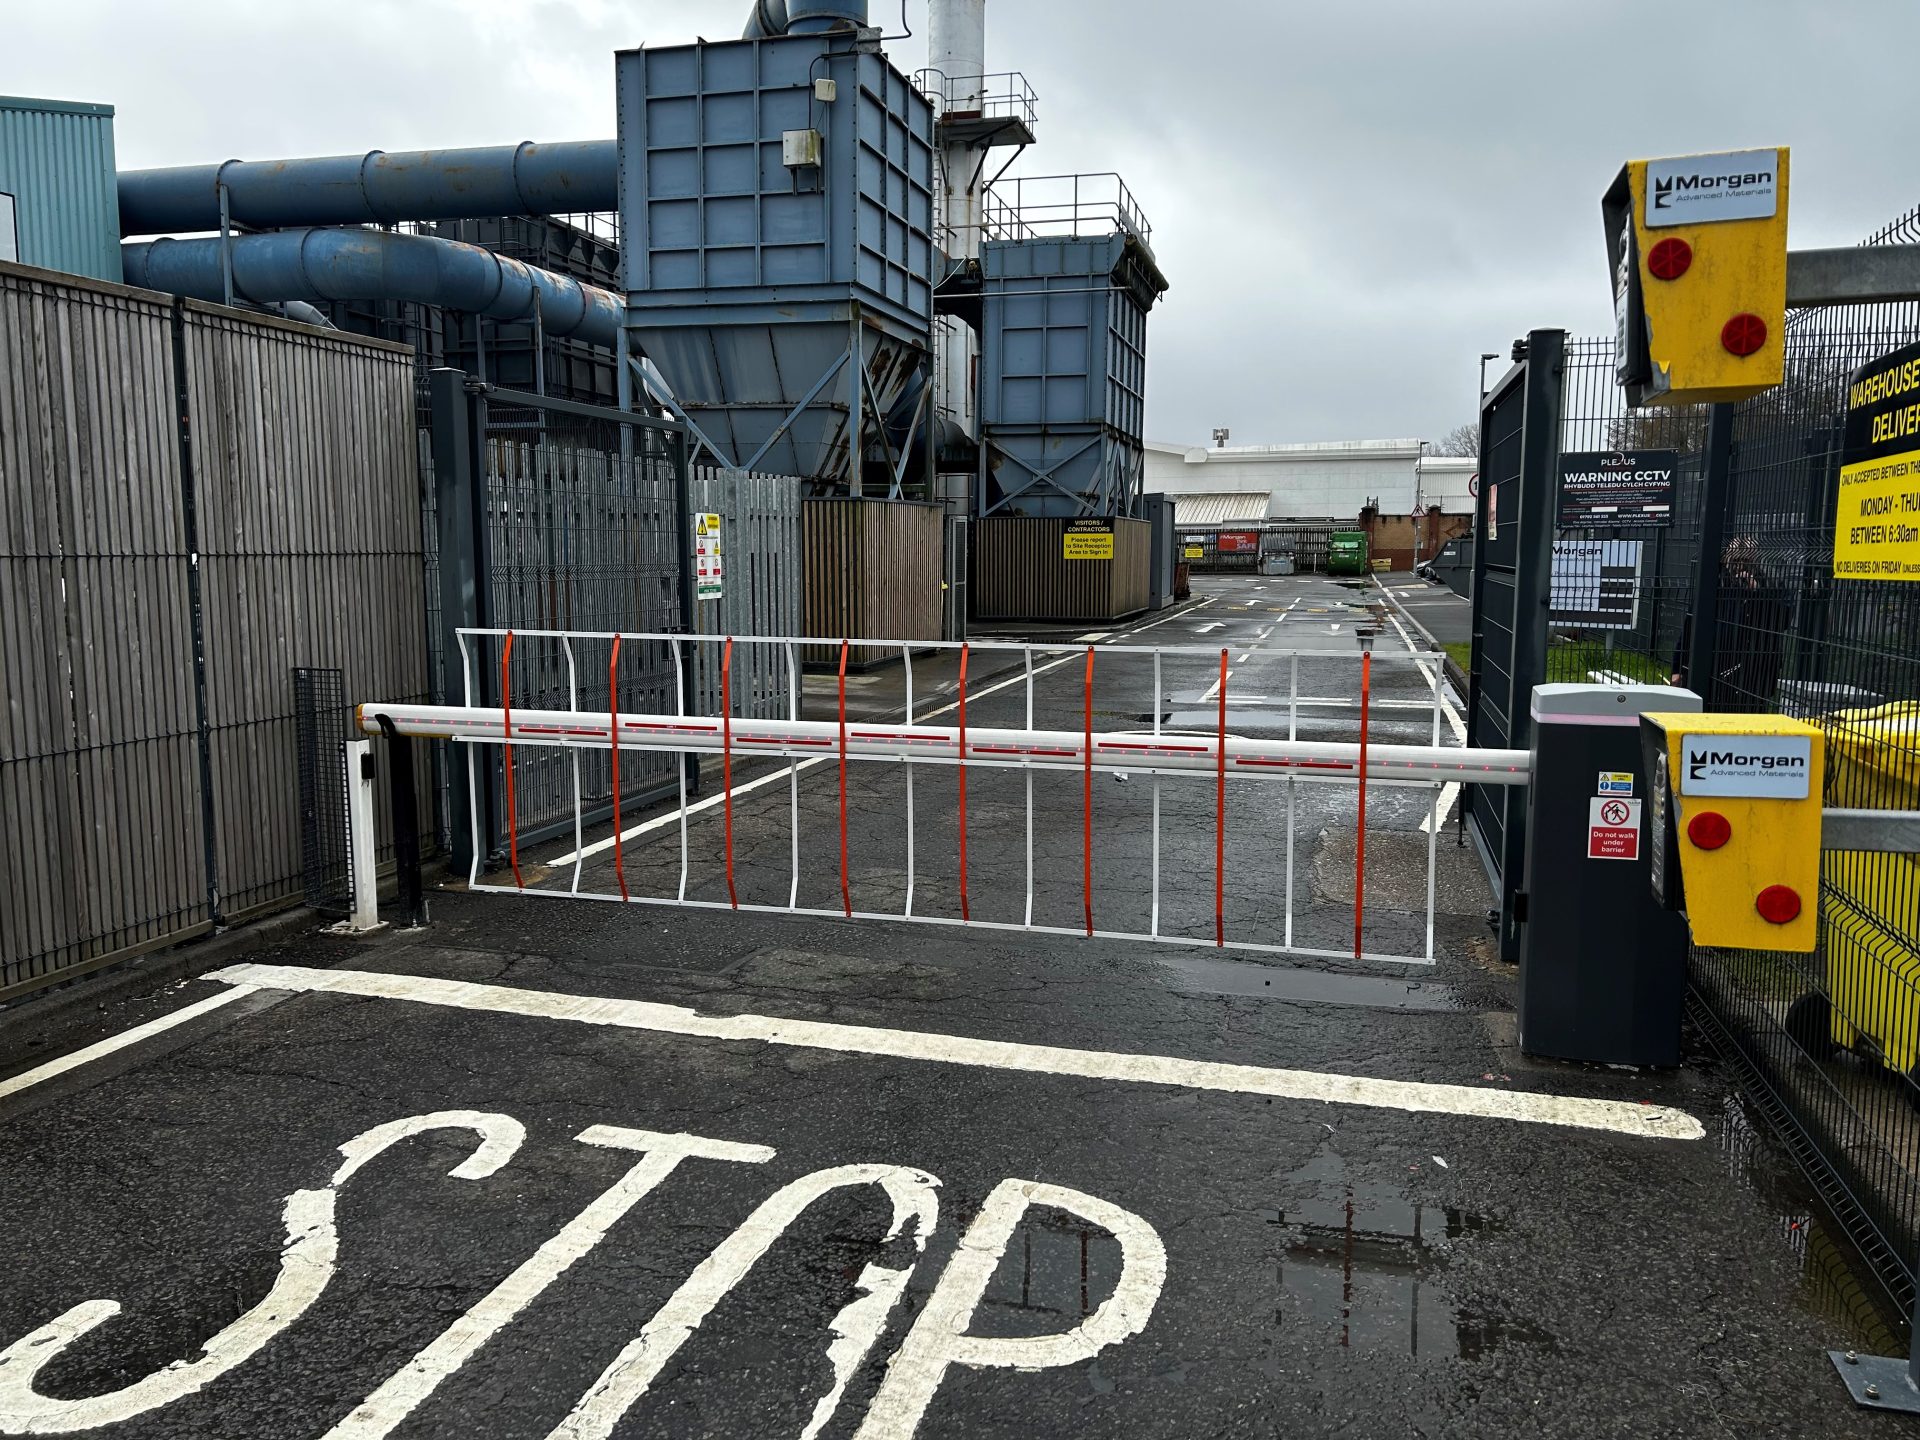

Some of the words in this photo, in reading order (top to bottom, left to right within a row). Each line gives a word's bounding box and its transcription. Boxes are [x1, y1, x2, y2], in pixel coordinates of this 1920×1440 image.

[1676, 172, 1772, 190] Morgan
[1676, 192, 1722, 202] Advanced
[1725, 188, 1772, 198] Materials
[1850, 358, 1920, 411] WAREHOUSE
[1564, 471, 1632, 483] WARNING
[1635, 470, 1671, 481] CCTV
[1842, 473, 1854, 486] ONLY
[1854, 468, 1880, 483] ACCEPTED
[1881, 462, 1909, 480] BETWEEN
[1860, 495, 1894, 517] MONDAY
[1901, 492, 1920, 512] THU
[1850, 525, 1887, 544] BETWEEN
[1888, 524, 1918, 543] 6:30am
[1552, 547, 1602, 556] Morgan
[1844, 561, 1871, 573] DELIVERIES
[1872, 561, 1880, 573] ON
[1881, 561, 1902, 573] FRIDAY
[1710, 752, 1805, 769] Morgan
[1758, 770, 1804, 778] Materials
[0, 1109, 1168, 1440] STOP
